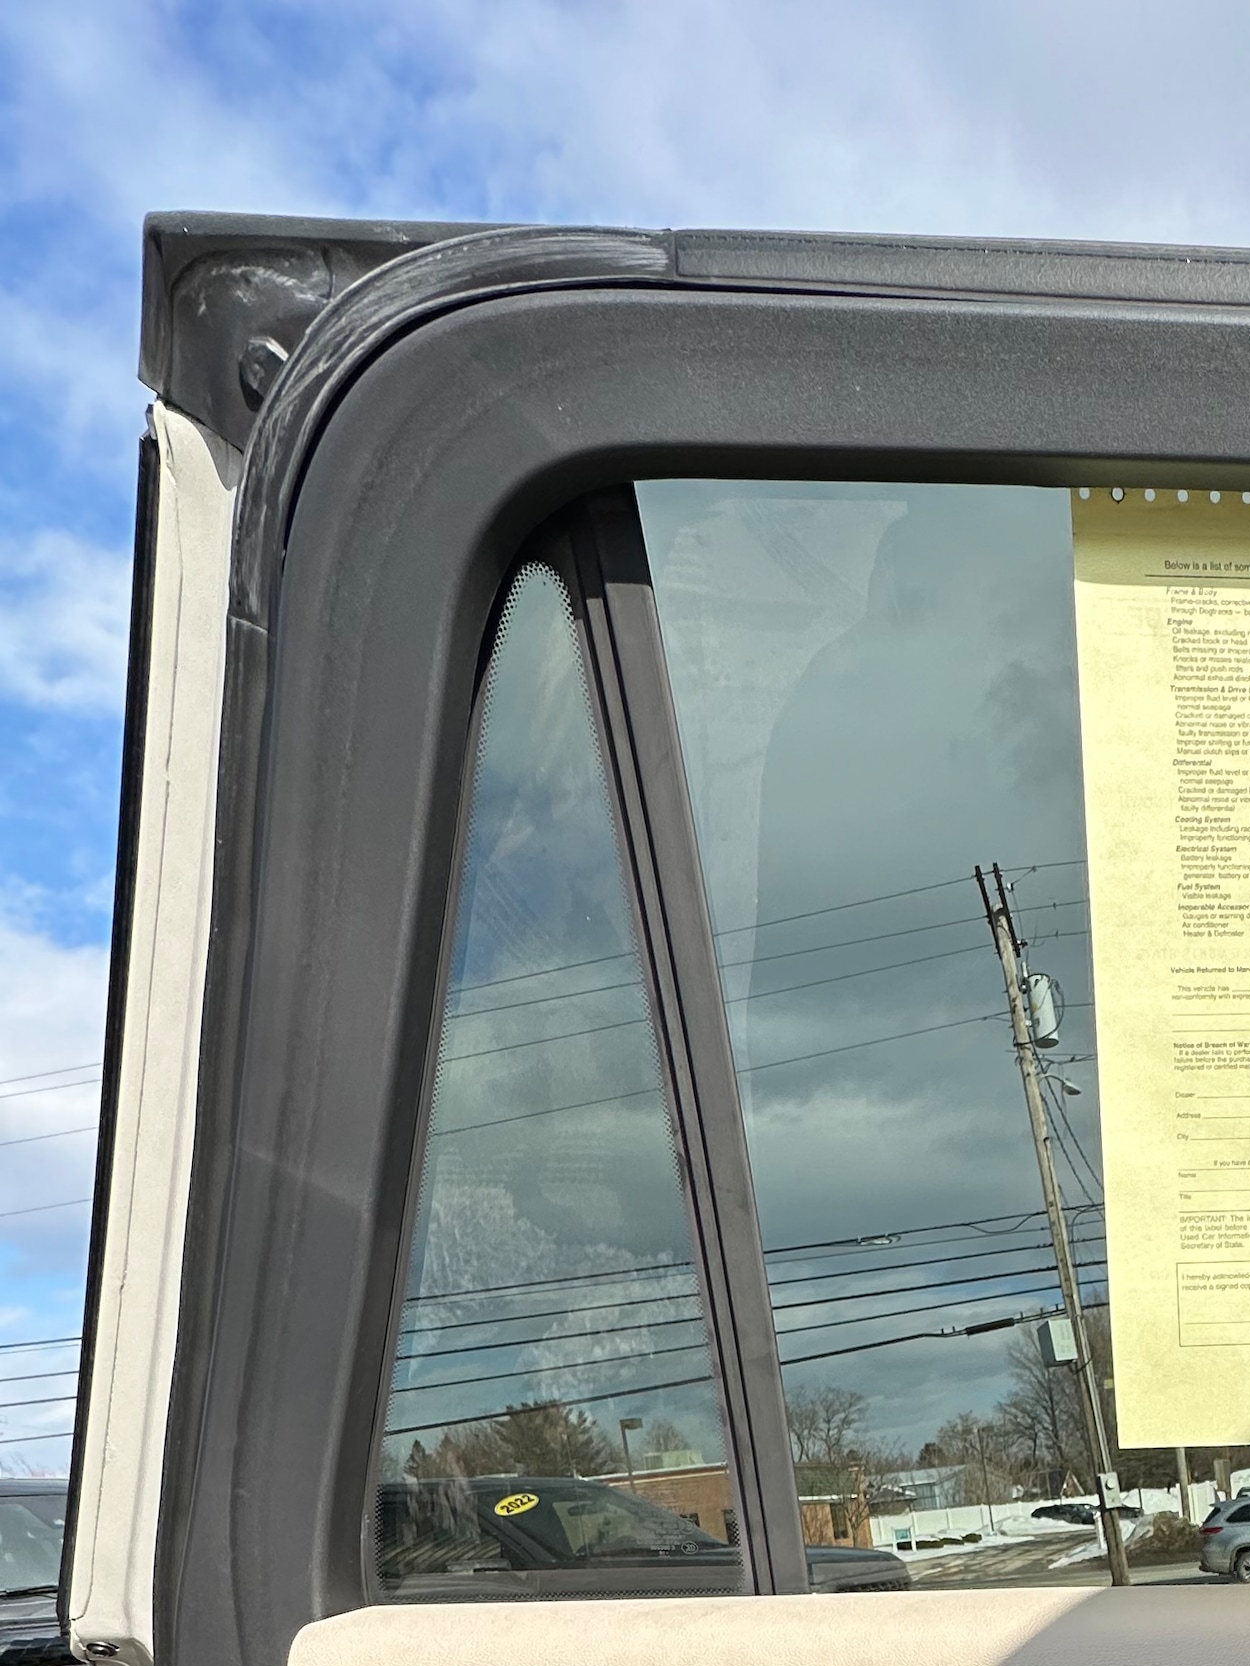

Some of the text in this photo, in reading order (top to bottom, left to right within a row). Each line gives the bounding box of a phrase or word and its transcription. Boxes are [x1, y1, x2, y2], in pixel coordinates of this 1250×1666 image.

[1164, 560, 1191, 570] Below
[1191, 560, 1200, 570] is
[1209, 561, 1222, 571] list
[1223, 561, 1232, 571] of
[500, 1494, 535, 1513] 2022
